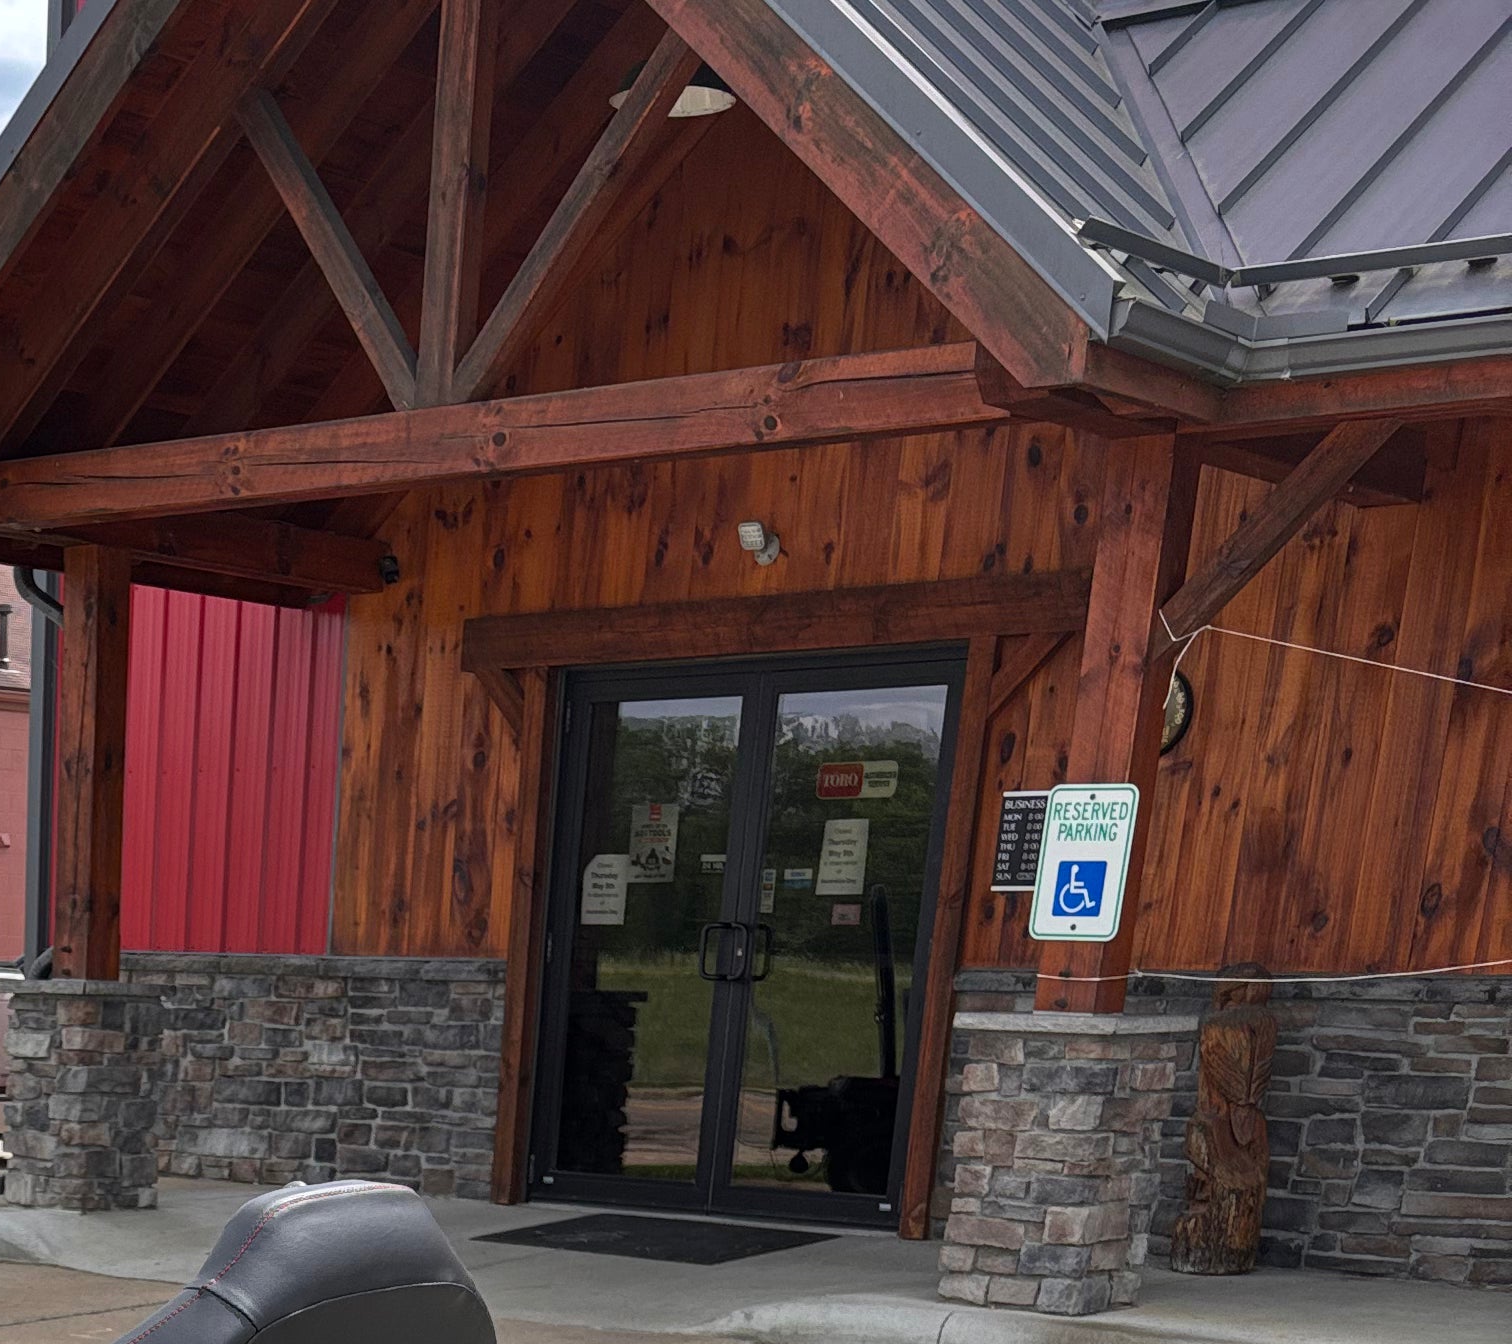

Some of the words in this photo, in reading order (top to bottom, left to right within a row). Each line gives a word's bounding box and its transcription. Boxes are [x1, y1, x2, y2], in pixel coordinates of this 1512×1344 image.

[823, 772, 859, 788] TORO
[1004, 799, 1047, 810] BUSINESS
[1052, 801, 1129, 821] RESERVED
[1003, 813, 1023, 821] MON
[1003, 823, 1017, 831] TUE
[1057, 822, 1119, 842] PARKING
[1001, 833, 1019, 841] WED
[1000, 843, 1016, 851] THU
[998, 853, 1010, 861] FRI
[997, 862, 1010, 870] SAT
[996, 872, 1012, 881] SUN
